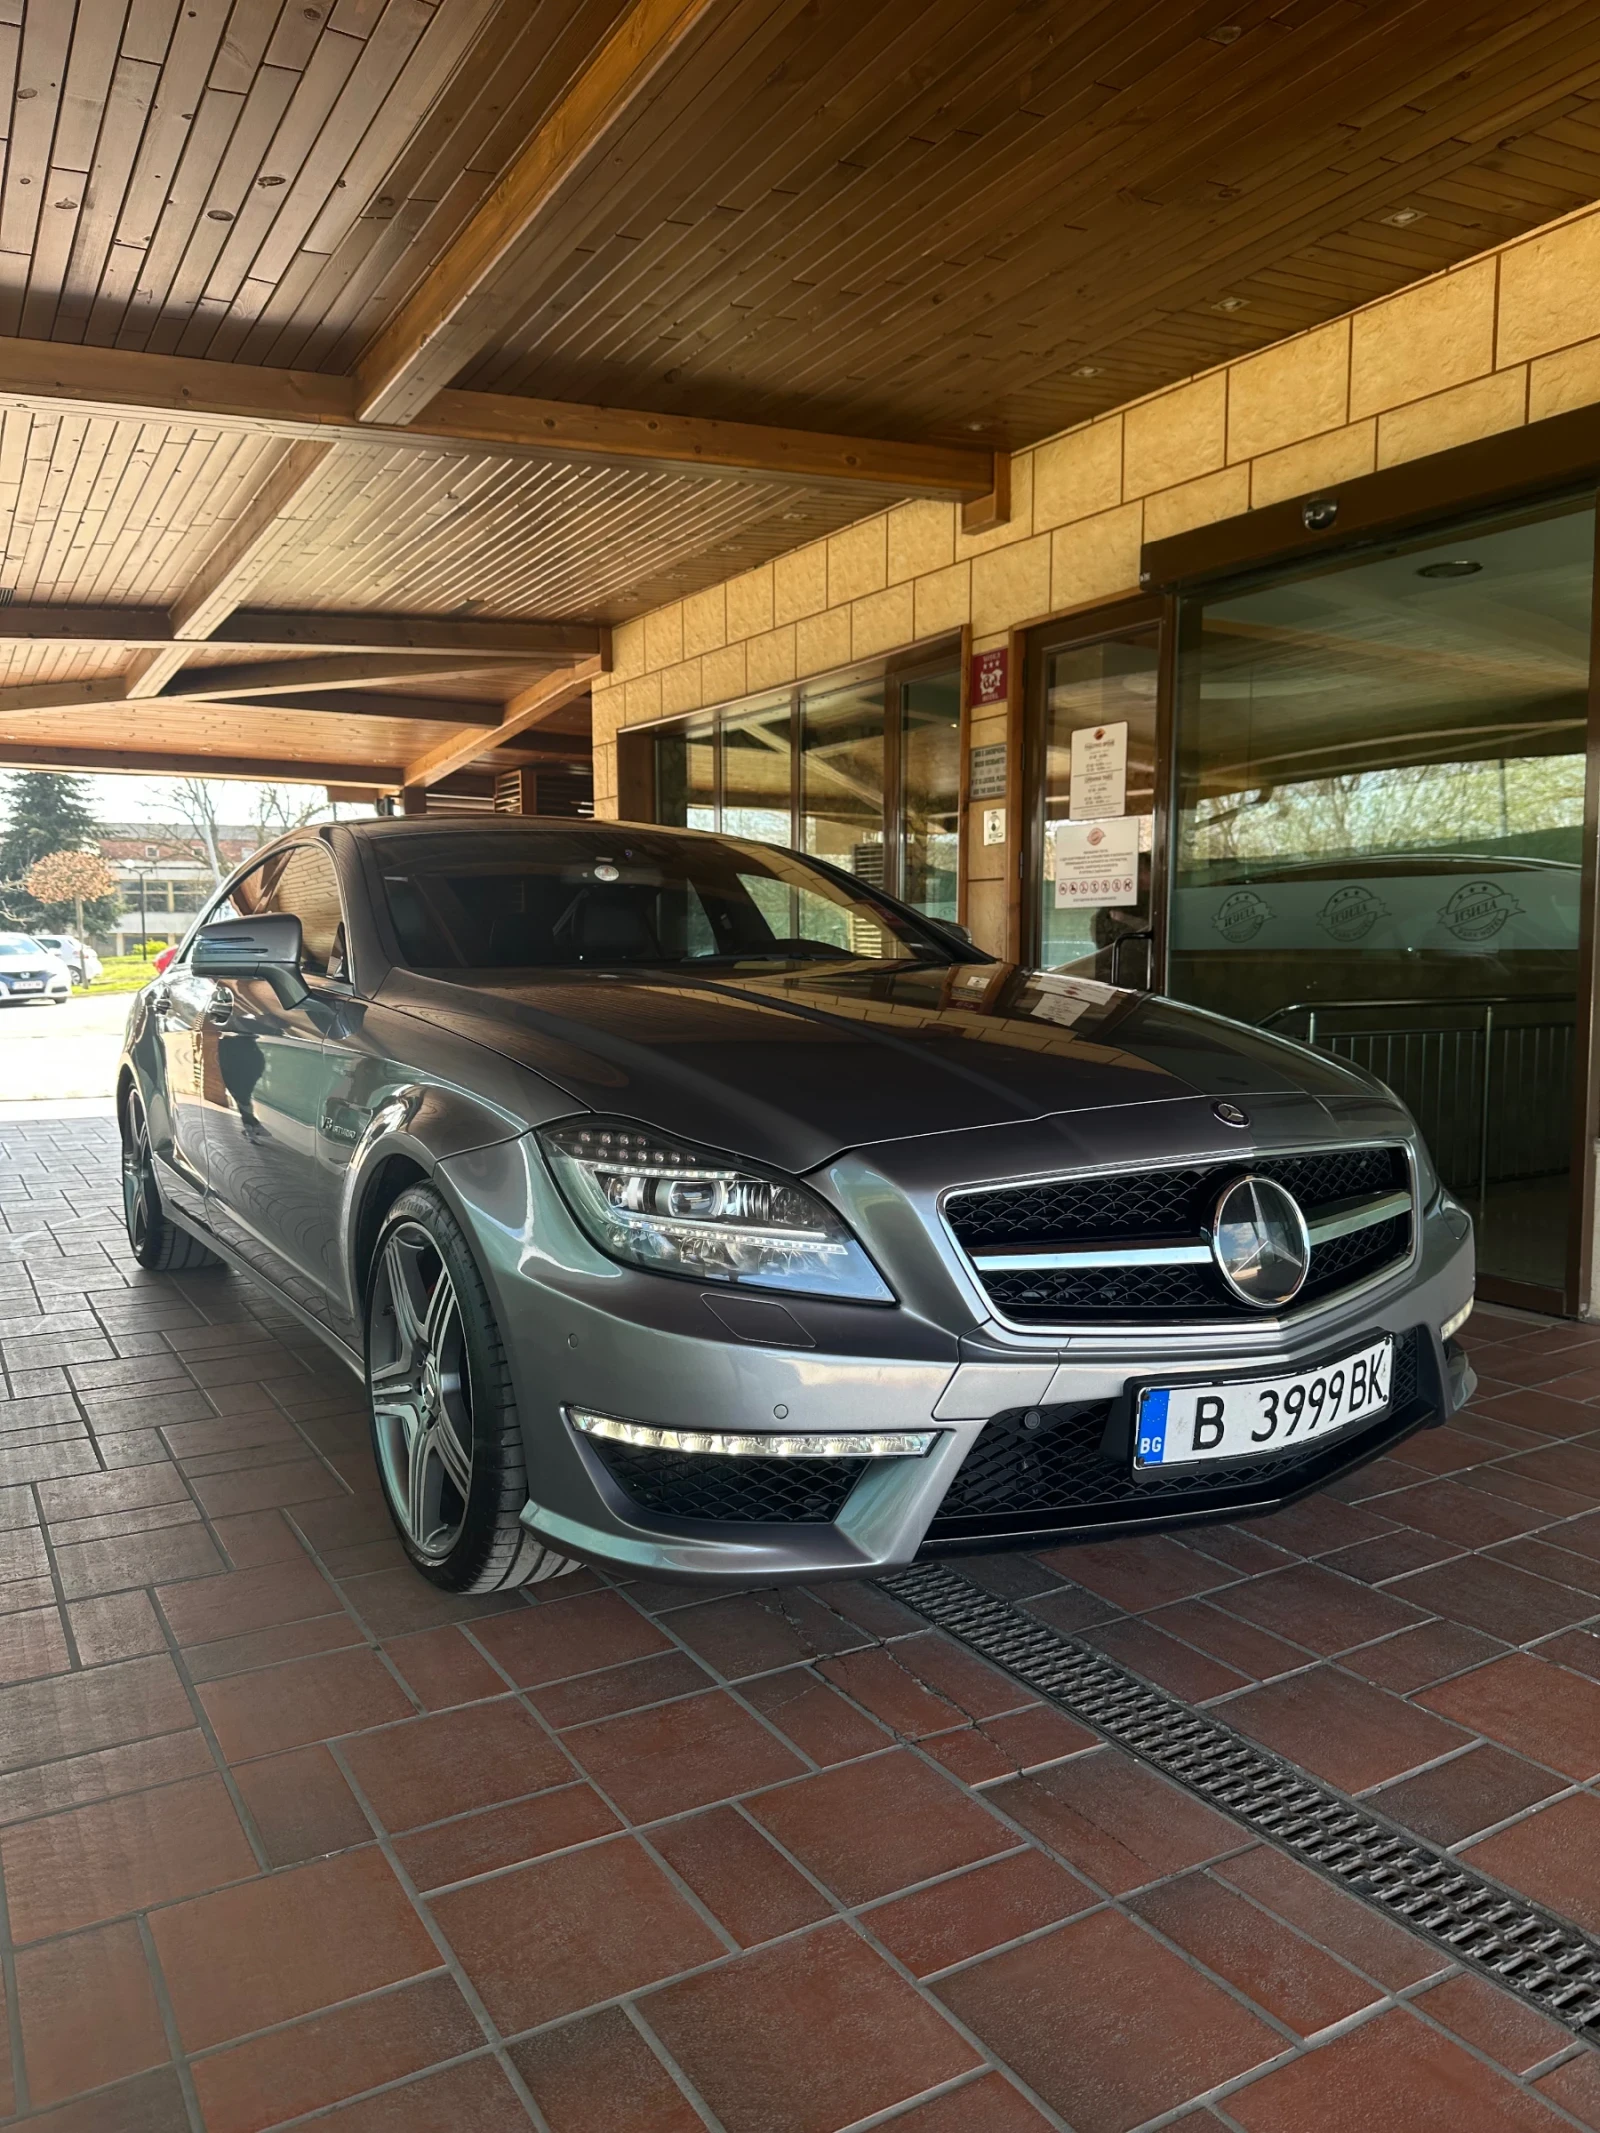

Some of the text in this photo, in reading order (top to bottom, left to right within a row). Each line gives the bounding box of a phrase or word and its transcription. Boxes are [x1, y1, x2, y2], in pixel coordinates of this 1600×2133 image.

[1454, 899, 1498, 923] ИЗИДА
[1191, 1395, 1225, 1451] B
[1140, 1437, 1162, 1454] BG
